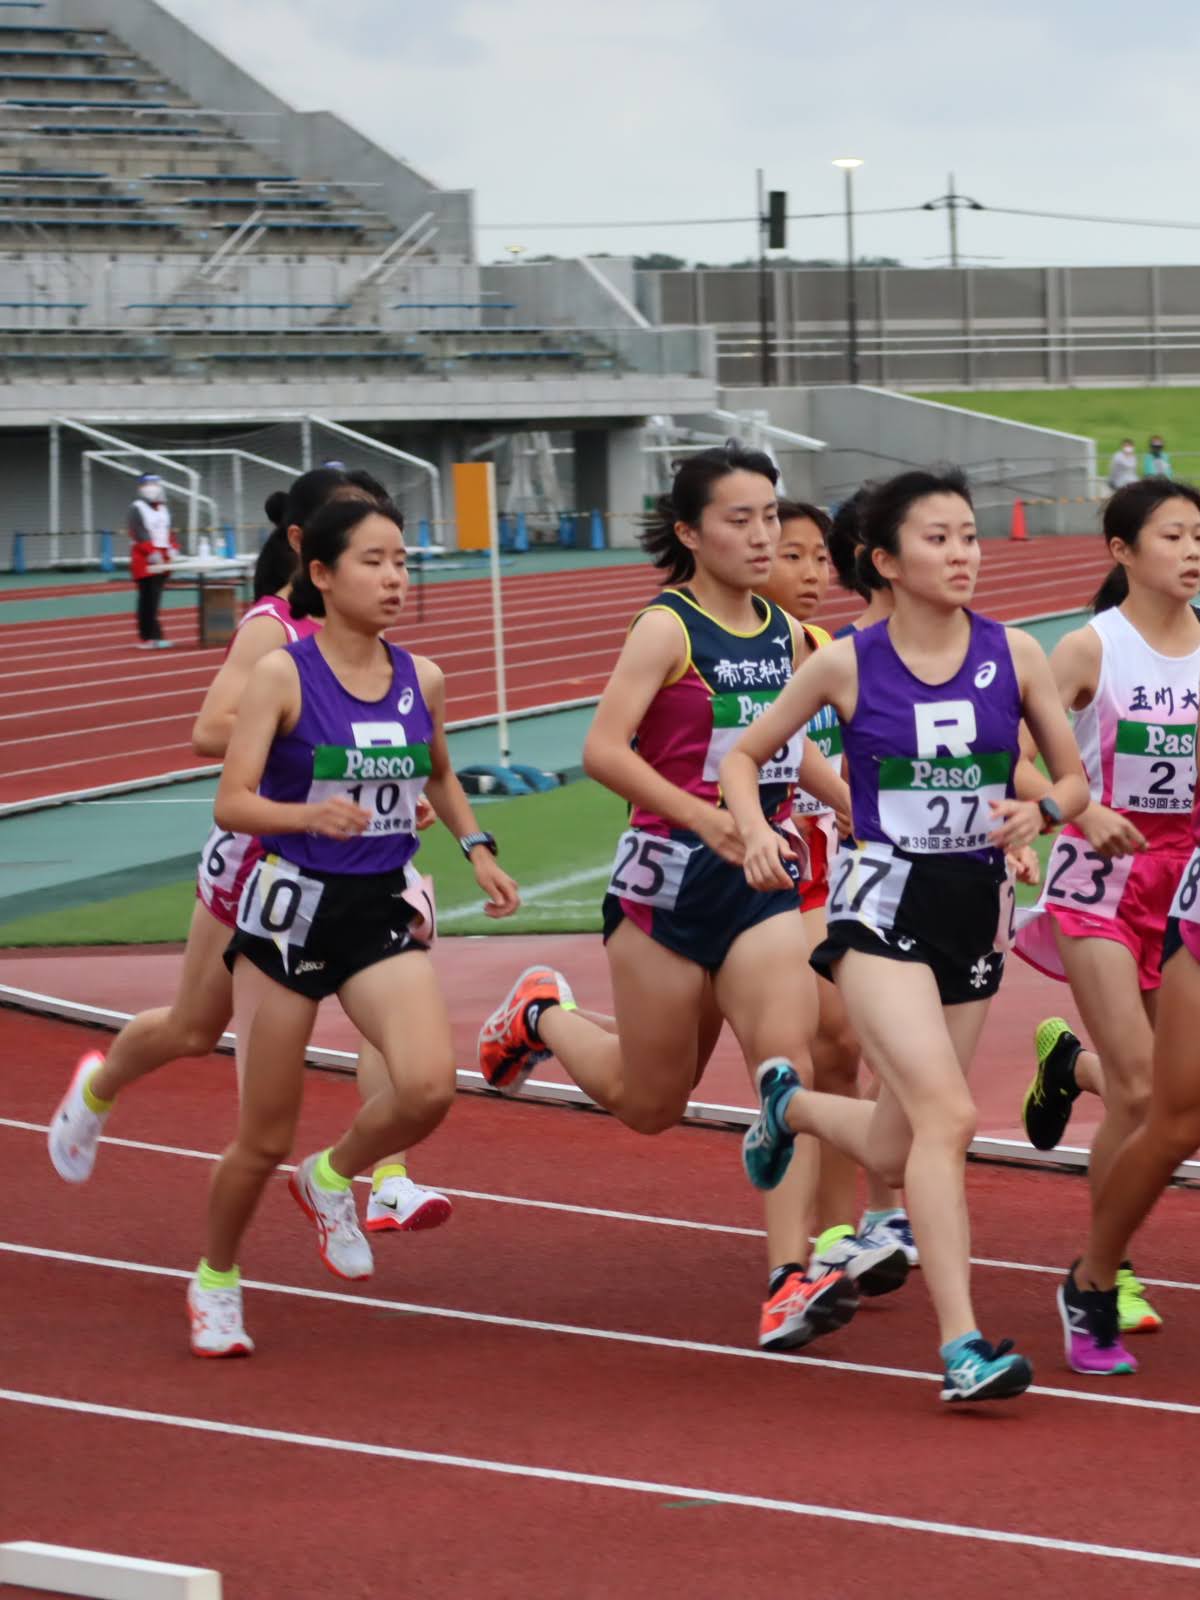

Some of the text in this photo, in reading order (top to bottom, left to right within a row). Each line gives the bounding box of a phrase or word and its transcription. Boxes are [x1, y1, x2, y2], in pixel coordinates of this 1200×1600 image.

[914, 700, 977, 759] R
[343, 749, 415, 780] Pasco
[346, 783, 399, 815] 10
[926, 795, 979, 836] 27
[207, 832, 236, 877] 6
[610, 836, 675, 897] 25
[1047, 842, 1115, 905] 23
[242, 868, 302, 933] 10
[829, 857, 892, 914] 27
